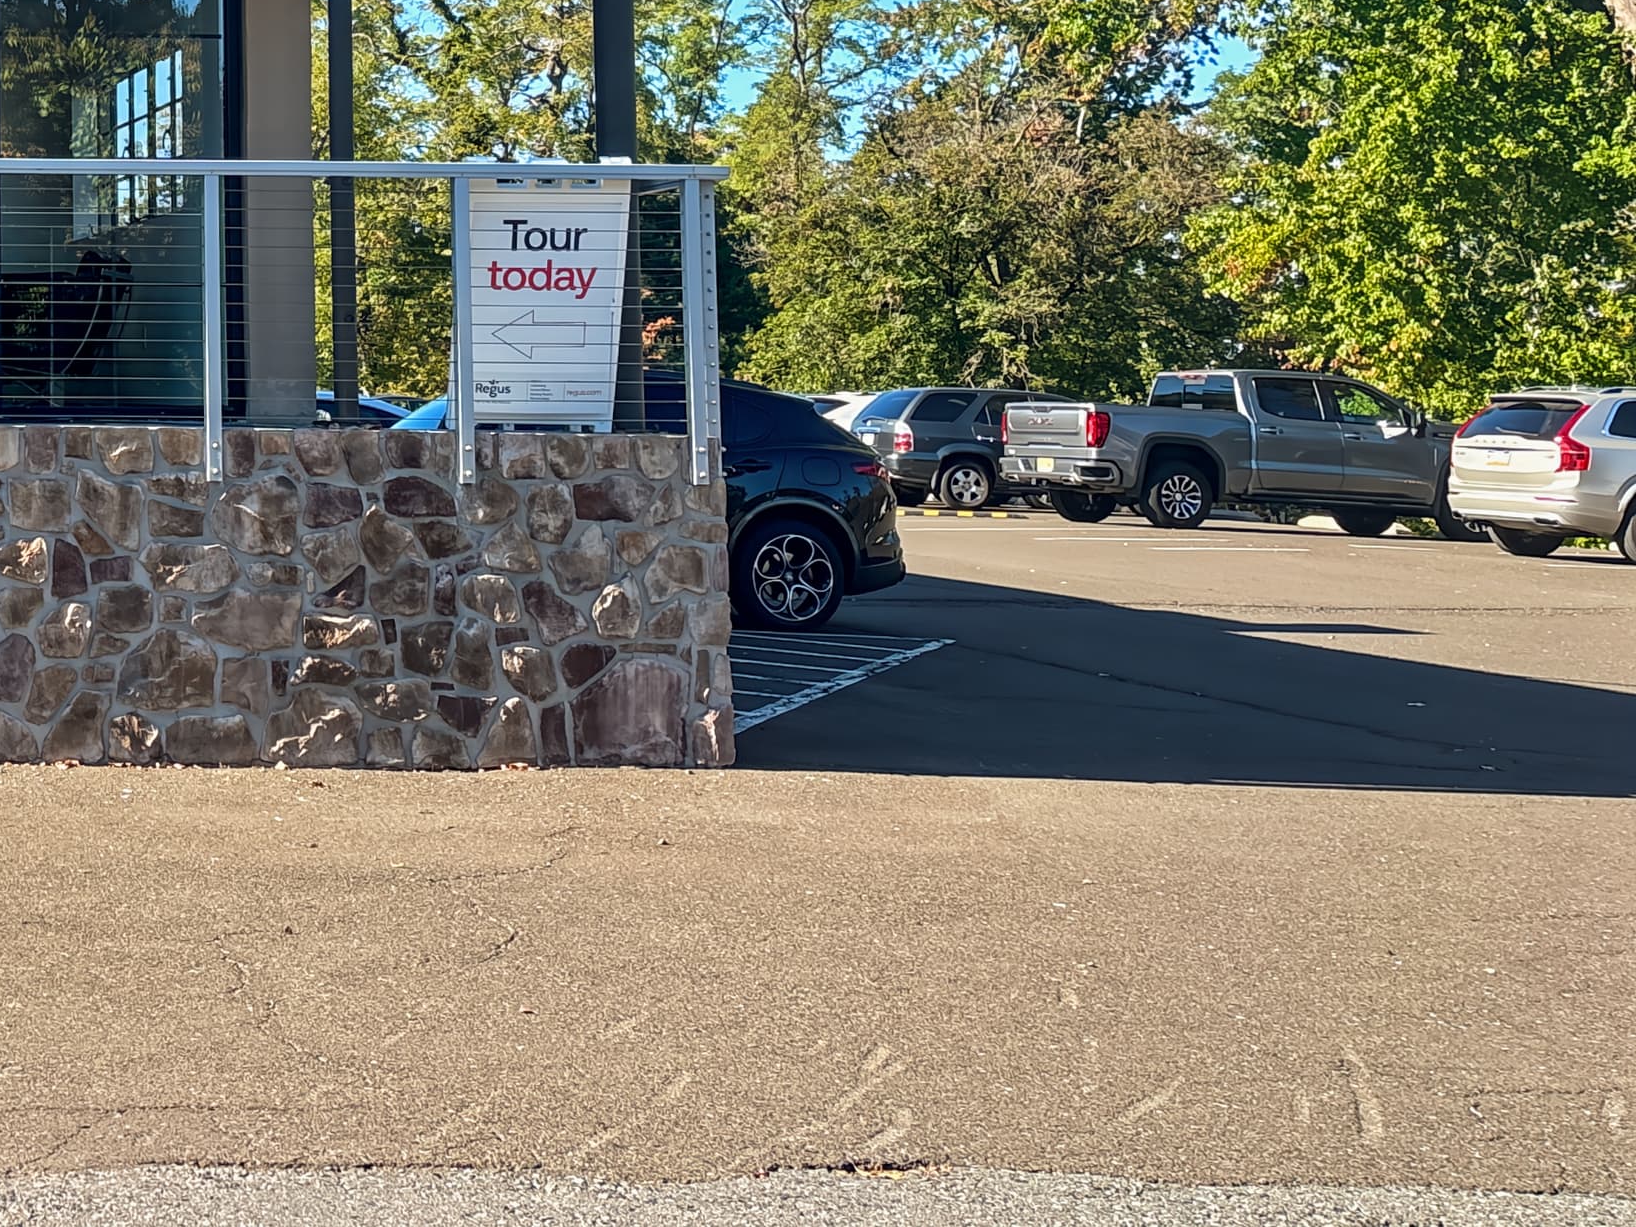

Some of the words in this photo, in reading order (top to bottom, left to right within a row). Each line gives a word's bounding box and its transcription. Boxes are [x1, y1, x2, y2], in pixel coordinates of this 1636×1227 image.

[503, 219, 588, 251] Tour
[487, 259, 598, 299] today
[474, 380, 511, 398] Regus
